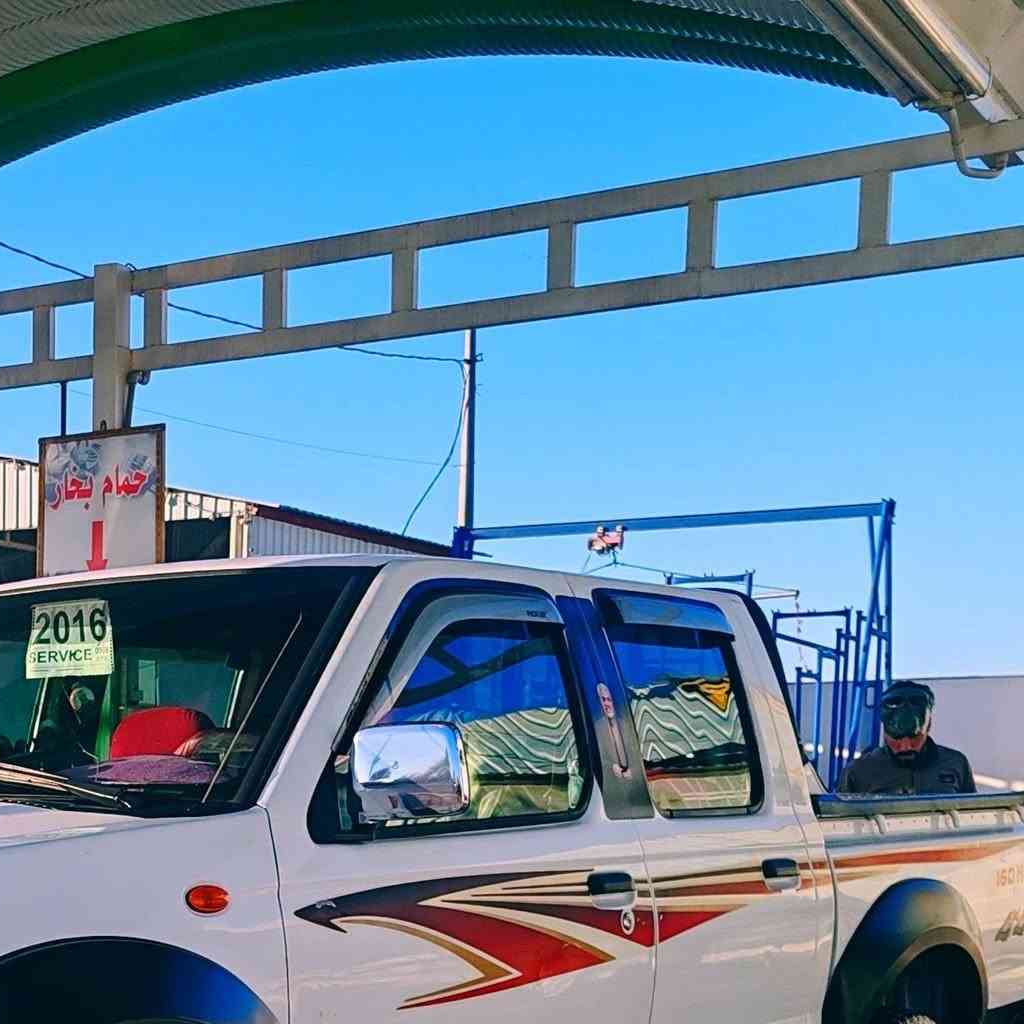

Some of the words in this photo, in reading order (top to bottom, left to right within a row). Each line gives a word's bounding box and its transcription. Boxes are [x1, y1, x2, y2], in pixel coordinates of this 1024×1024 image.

[47, 466, 95, 511] بخار
[102, 463, 147, 508] حمام
[33, 608, 107, 645] 2016
[29, 648, 93, 663] SERVICE
